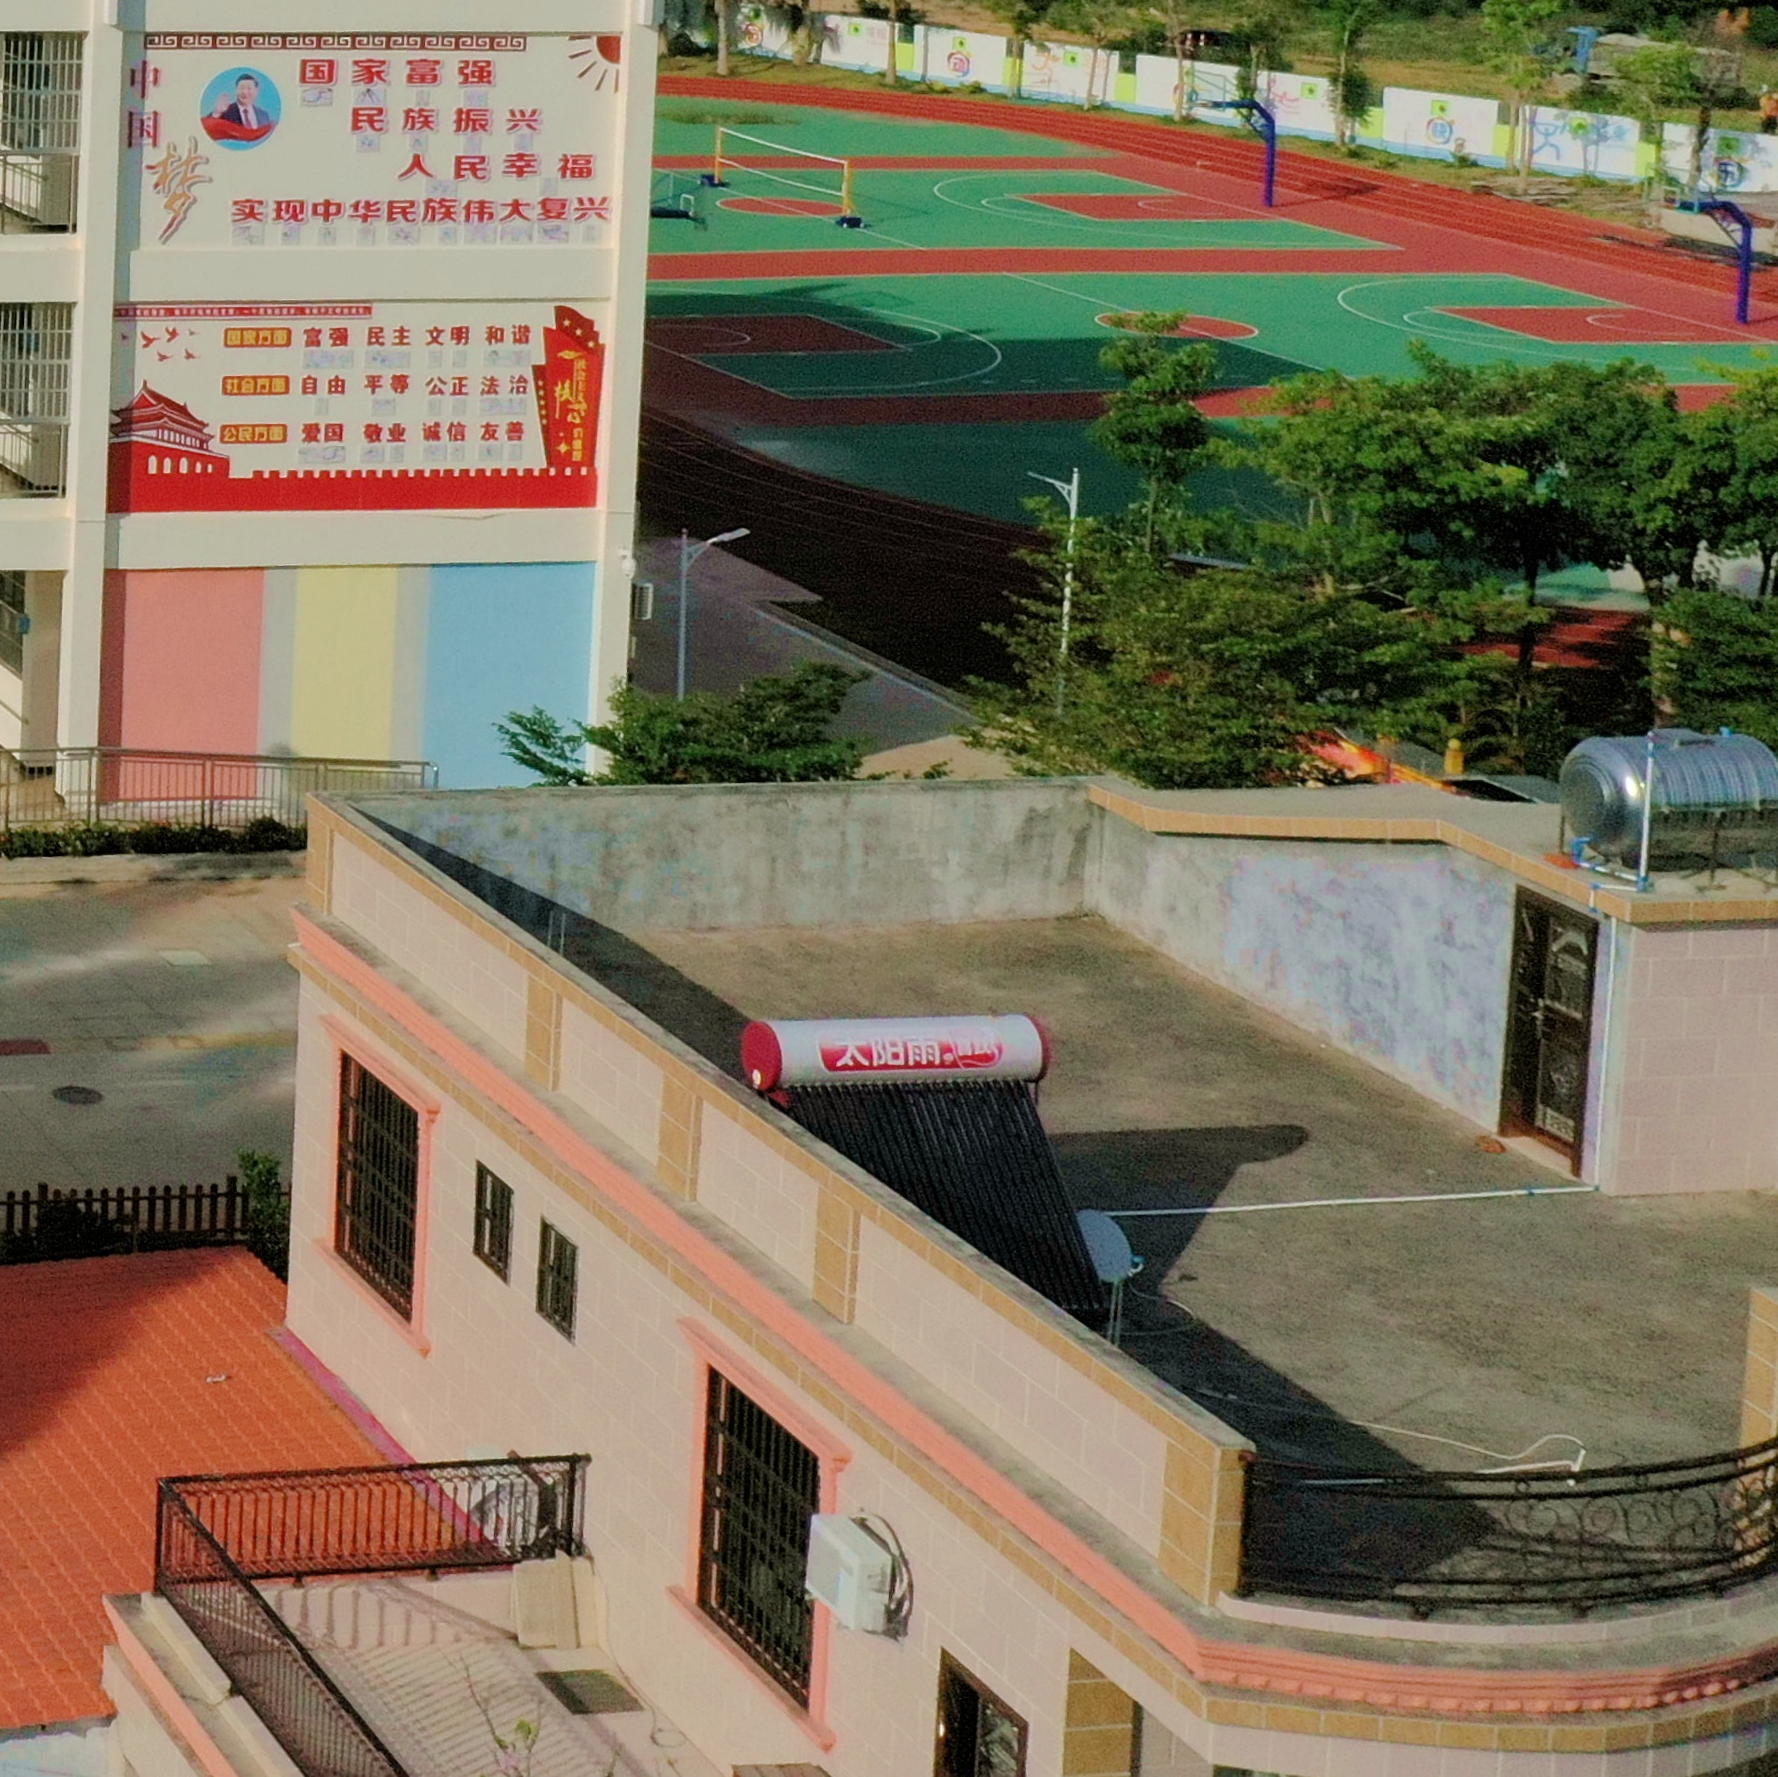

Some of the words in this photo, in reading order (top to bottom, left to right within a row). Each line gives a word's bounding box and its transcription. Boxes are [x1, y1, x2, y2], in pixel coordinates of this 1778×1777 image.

[299, 59, 494, 85] 国家富强
[350, 105, 541, 136] 民族振兴
[397, 150, 597, 181] 人民幸福
[231, 195, 611, 223] 实现中华民族伟大复兴
[302, 326, 349, 347] 富强
[366, 326, 412, 347] 民主
[424, 325, 470, 346] 文明
[484, 324, 531, 346] 和谐
[224, 378, 287, 394] 社会方面
[301, 374, 347, 395] 自由
[363, 374, 411, 396] 平等
[424, 375, 470, 396] 公正
[480, 374, 529, 396] 法治
[221, 426, 285, 442] 公民方面
[300, 421, 344, 443] 爱国
[363, 422, 407, 444] 敬业
[422, 422, 466, 443] 诚信
[479, 421, 525, 443] 友善
[836, 1036, 941, 1067] 太阳雨
